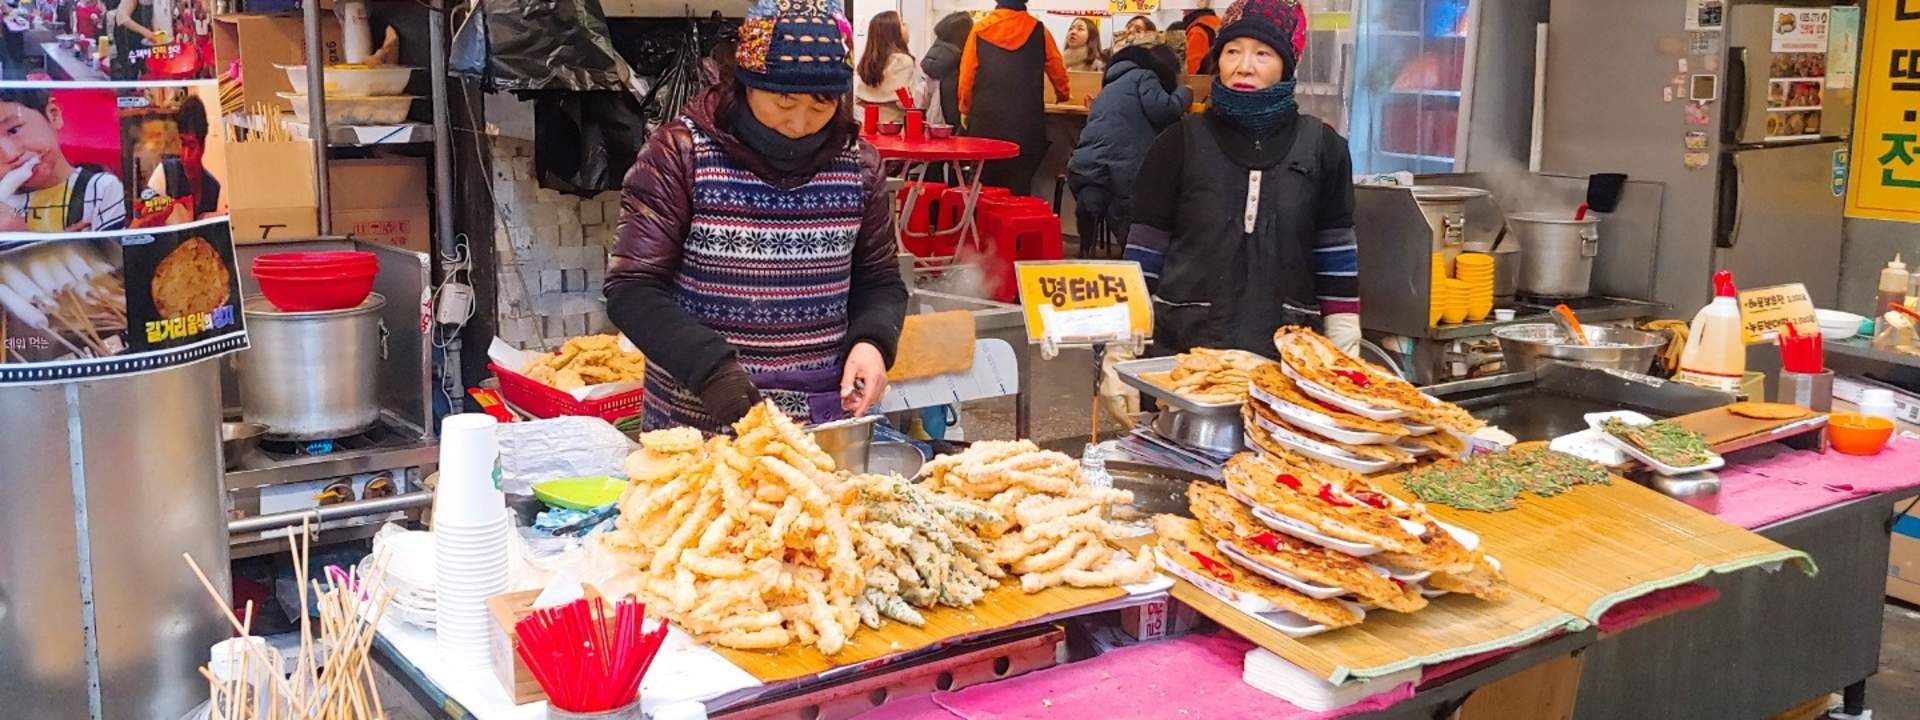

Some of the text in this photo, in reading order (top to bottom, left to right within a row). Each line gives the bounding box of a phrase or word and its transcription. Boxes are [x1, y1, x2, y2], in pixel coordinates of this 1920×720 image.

[1038, 273, 1129, 307] 명태전
[4, 336, 49, 349] 데워 먹는
[145, 316, 188, 343] 길거리
